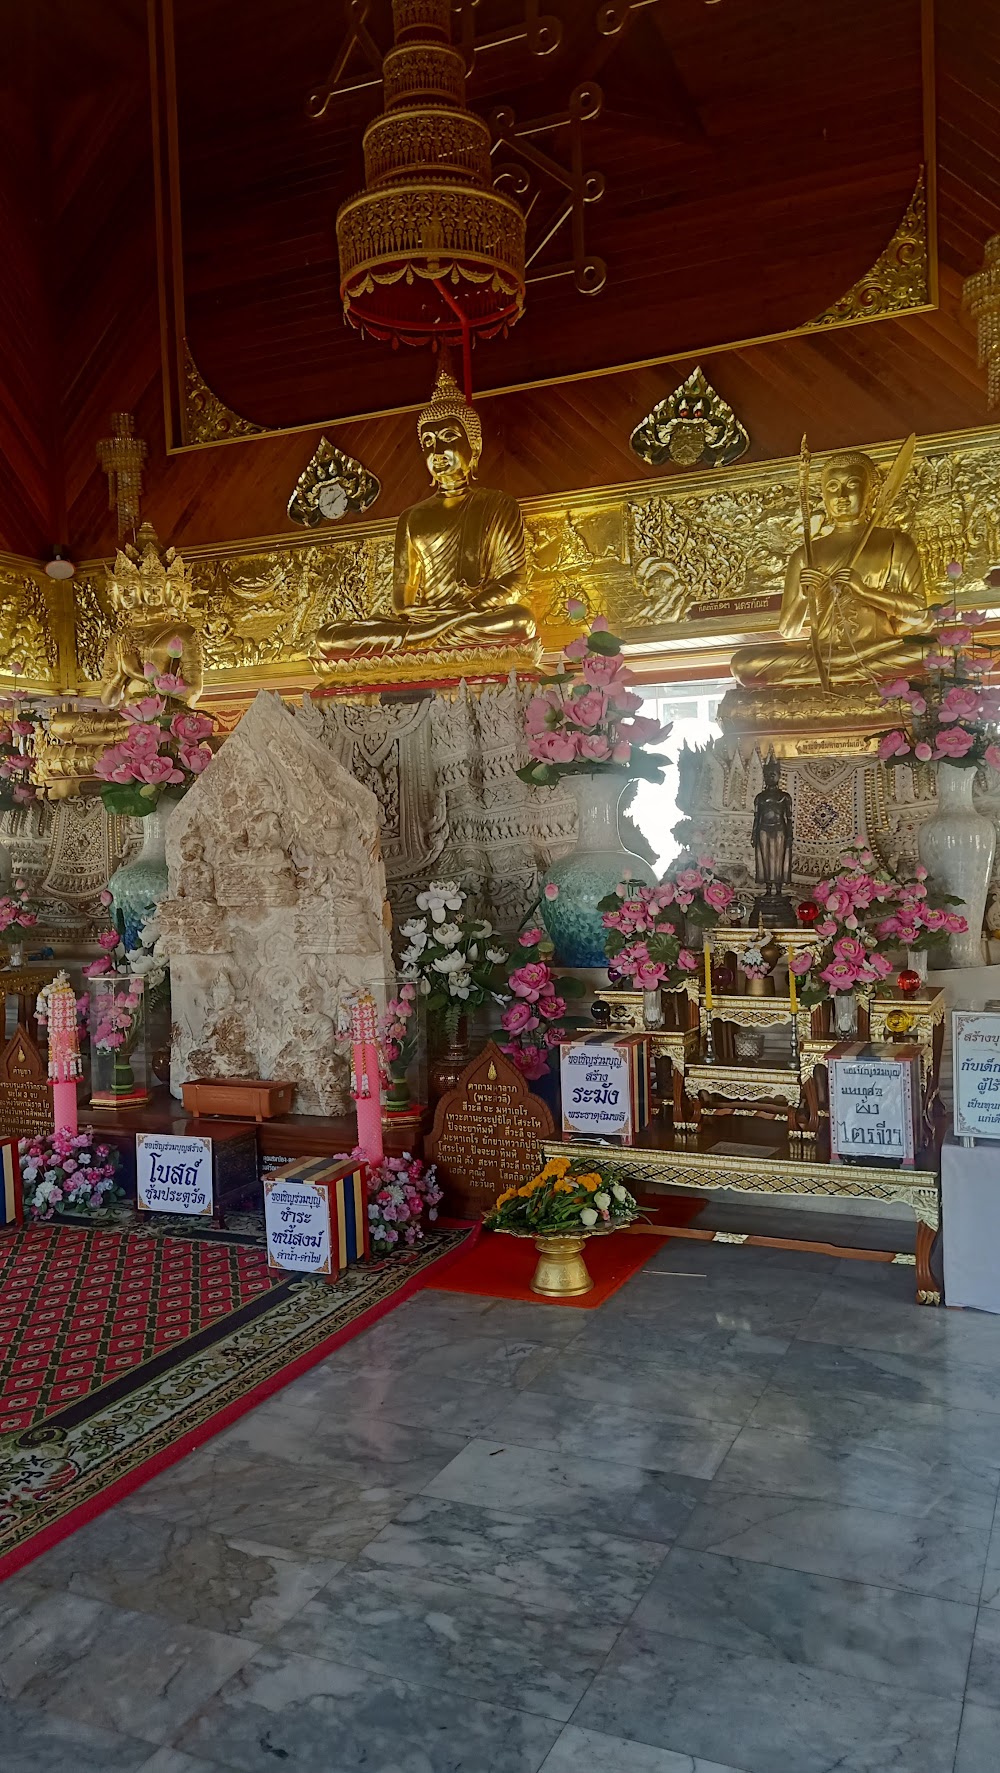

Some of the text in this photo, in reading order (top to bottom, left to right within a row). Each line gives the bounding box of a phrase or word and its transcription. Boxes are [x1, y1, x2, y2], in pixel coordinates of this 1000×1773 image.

[568, 1052, 623, 1069] ขอเชิญร่วมบุญ
[585, 1069, 609, 1082] สร้าง
[572, 1082, 620, 1105] ระฆัง
[526, 1131, 537, 1139] จะ
[144, 1140, 204, 1154] ขอเชิญร่วมบุญสร้าง
[149, 1152, 204, 1186] โบสถ์
[271, 1190, 321, 1209] ขอเชิญร่วมบุญ
[280, 1206, 312, 1224] ชำระ
[271, 1224, 325, 1248] หนี้สงฆ์
